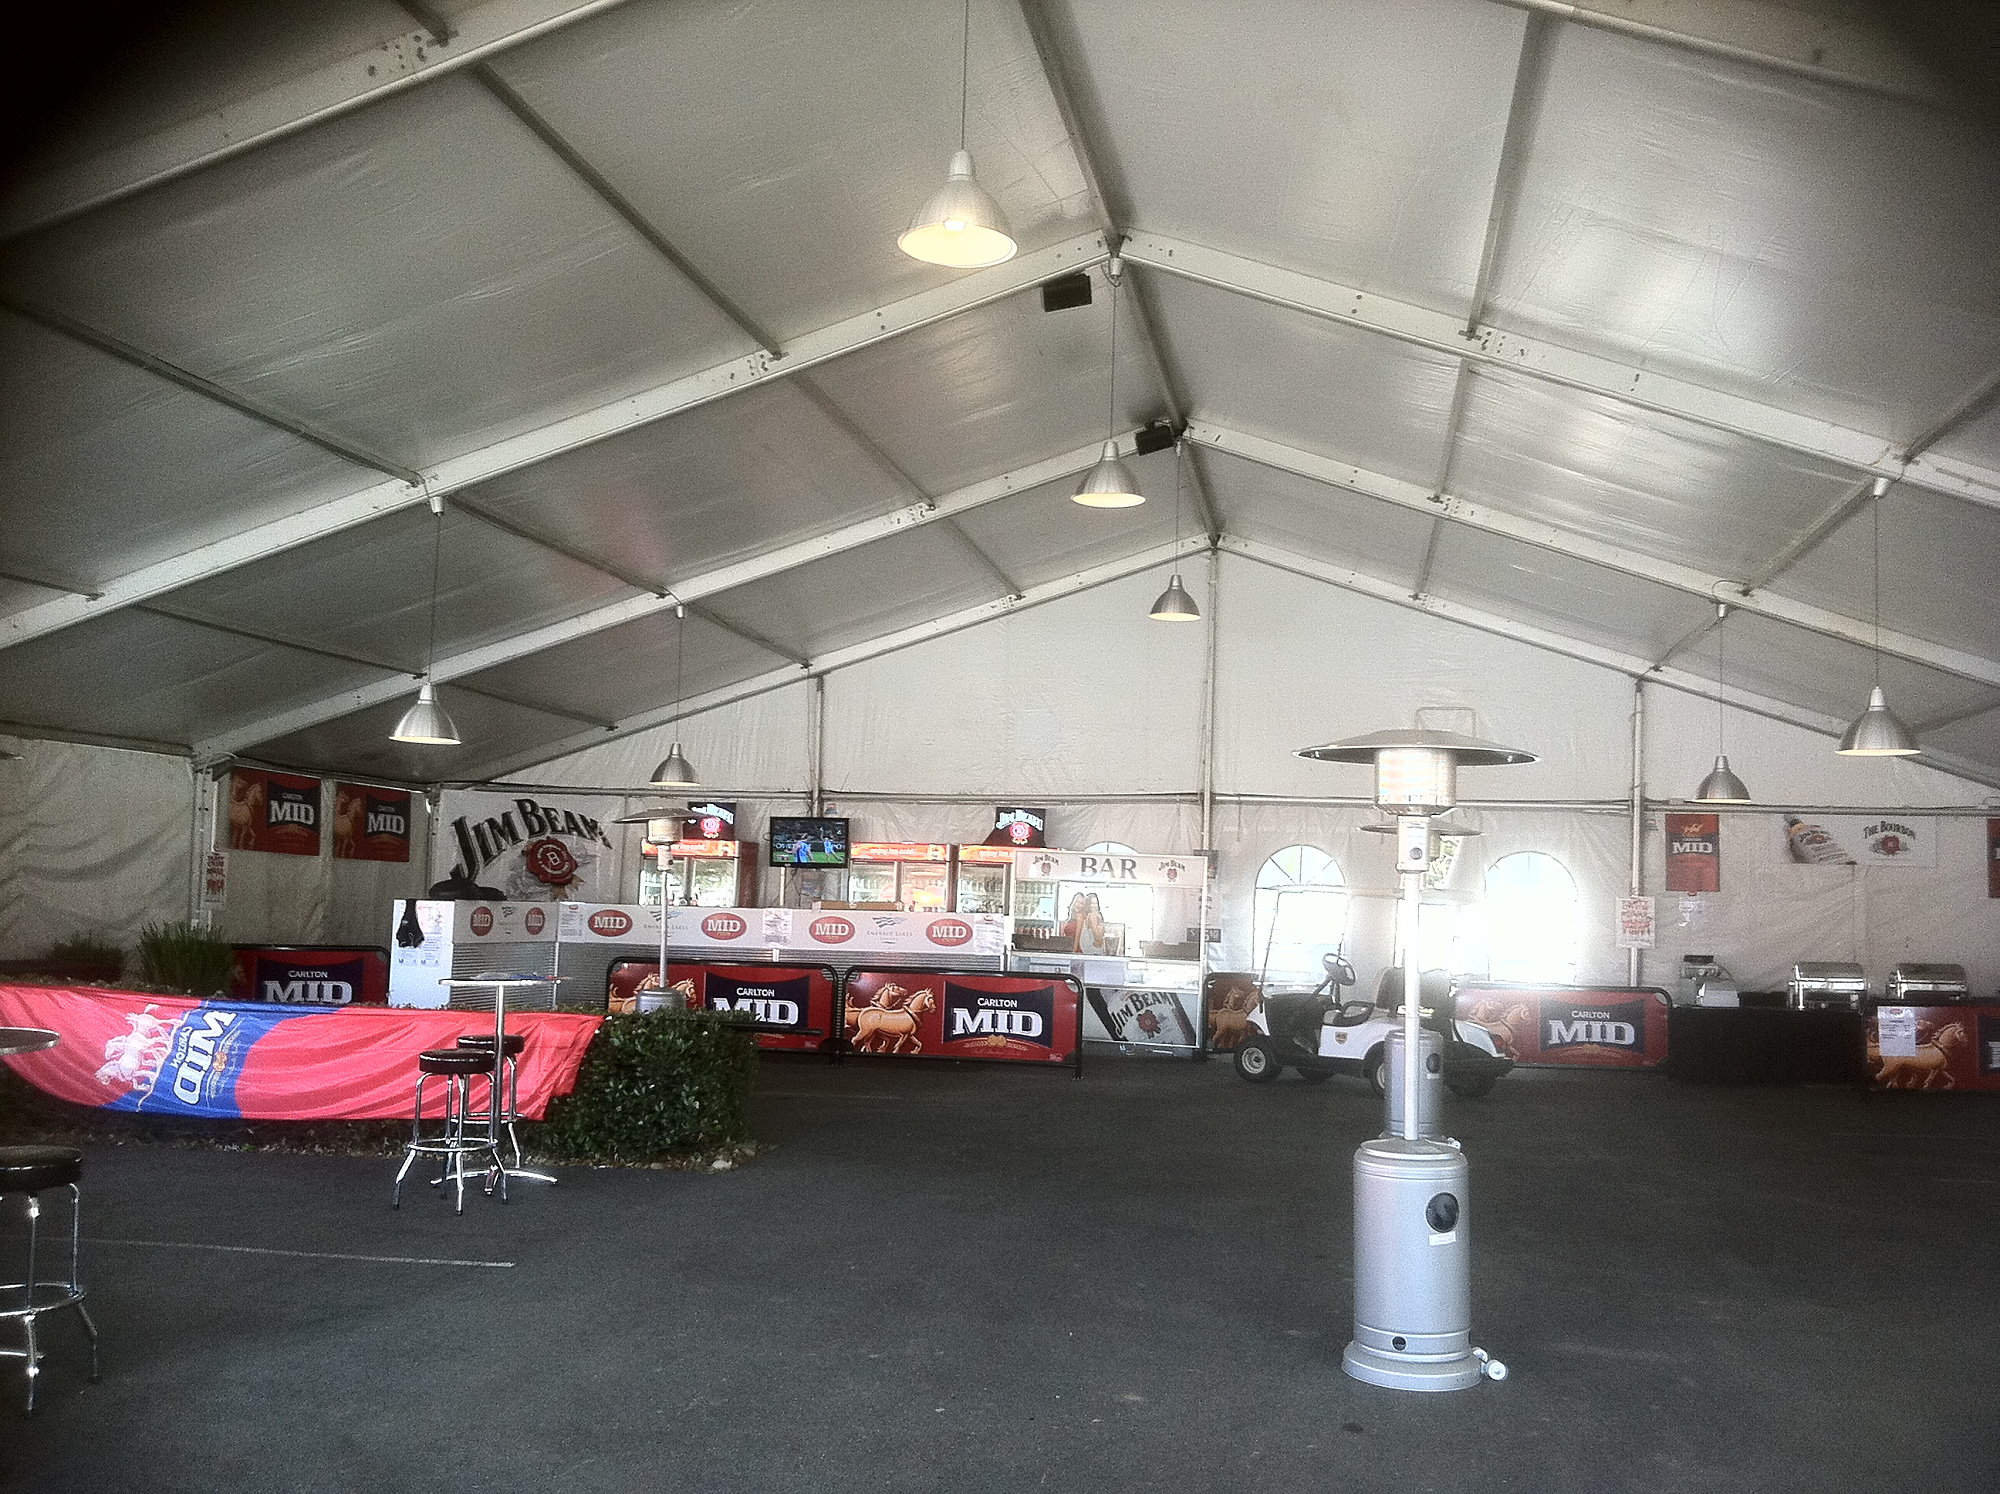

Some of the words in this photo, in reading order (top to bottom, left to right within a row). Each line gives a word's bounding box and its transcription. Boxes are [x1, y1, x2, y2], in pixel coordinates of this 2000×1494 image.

[270, 800, 315, 825] MID
[367, 812, 405, 834] MID
[450, 810, 525, 882] JIM
[512, 798, 613, 850] BEAM
[1672, 841, 1713, 854] MID
[1079, 856, 1138, 880] BAR
[593, 916, 628, 930] MID
[706, 919, 741, 933] MID
[814, 922, 850, 936] MID
[932, 924, 968, 939] MID
[288, 970, 328, 978] CARLTON
[264, 980, 353, 1004] MID
[736, 987, 775, 997] CARLTON
[977, 997, 1018, 1008] CARLTON
[952, 1007, 1043, 1037] MID
[1110, 1003, 1134, 1040] JIM
[1130, 991, 1174, 1013] BEAM
[1571, 1010, 1611, 1020] CARLTON
[1548, 1020, 1636, 1045] MID
